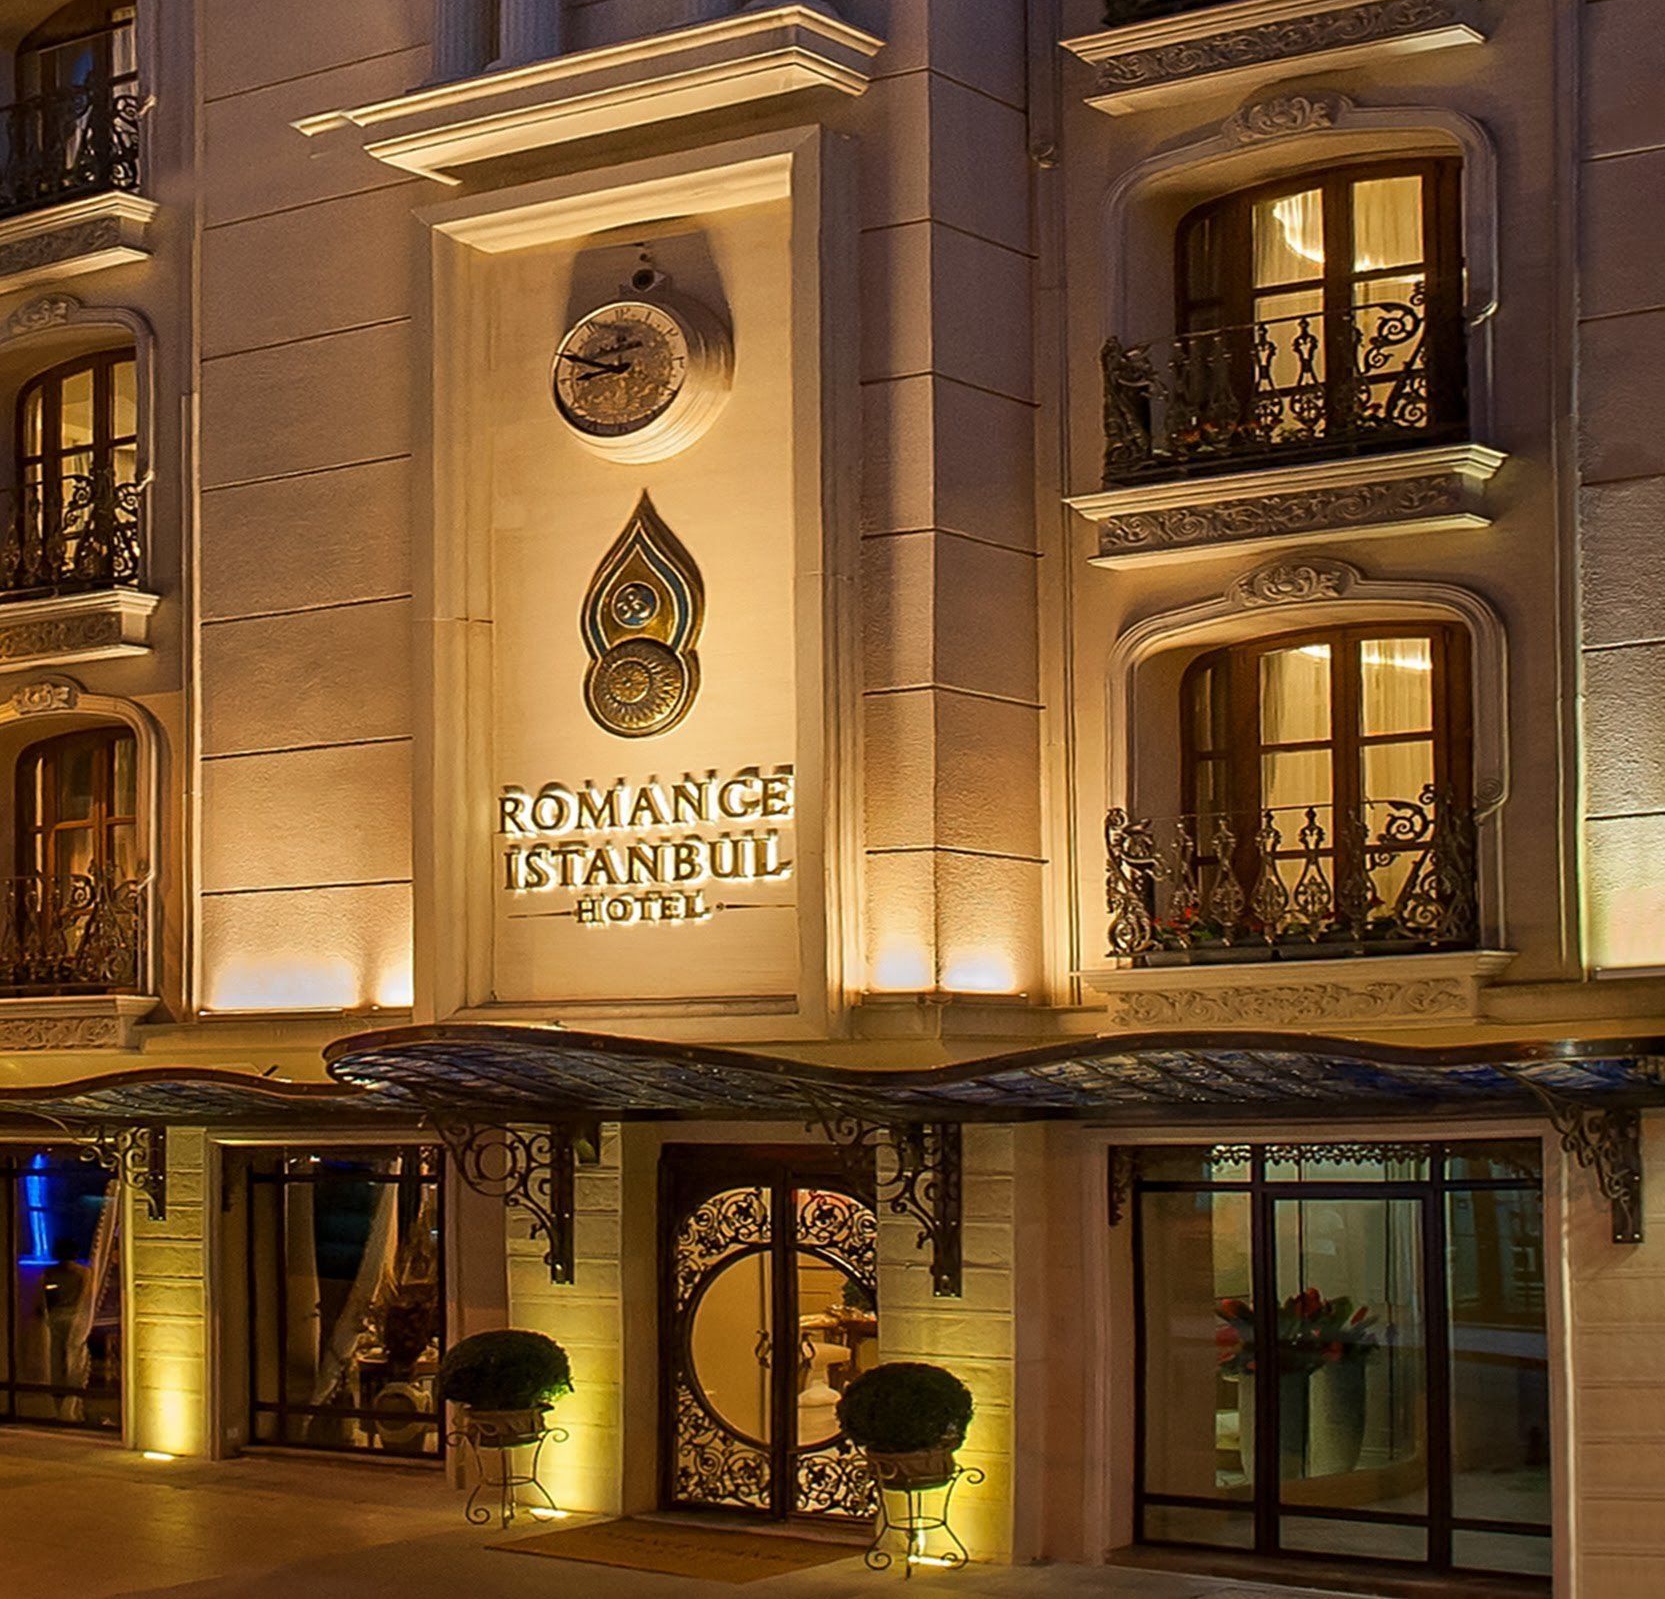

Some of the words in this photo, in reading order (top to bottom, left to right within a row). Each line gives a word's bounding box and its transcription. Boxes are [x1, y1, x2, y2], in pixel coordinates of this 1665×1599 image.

[498, 774, 794, 834] ROMANCE
[504, 837, 793, 890] ISTANBUL
[575, 895, 710, 924] HOTEL
